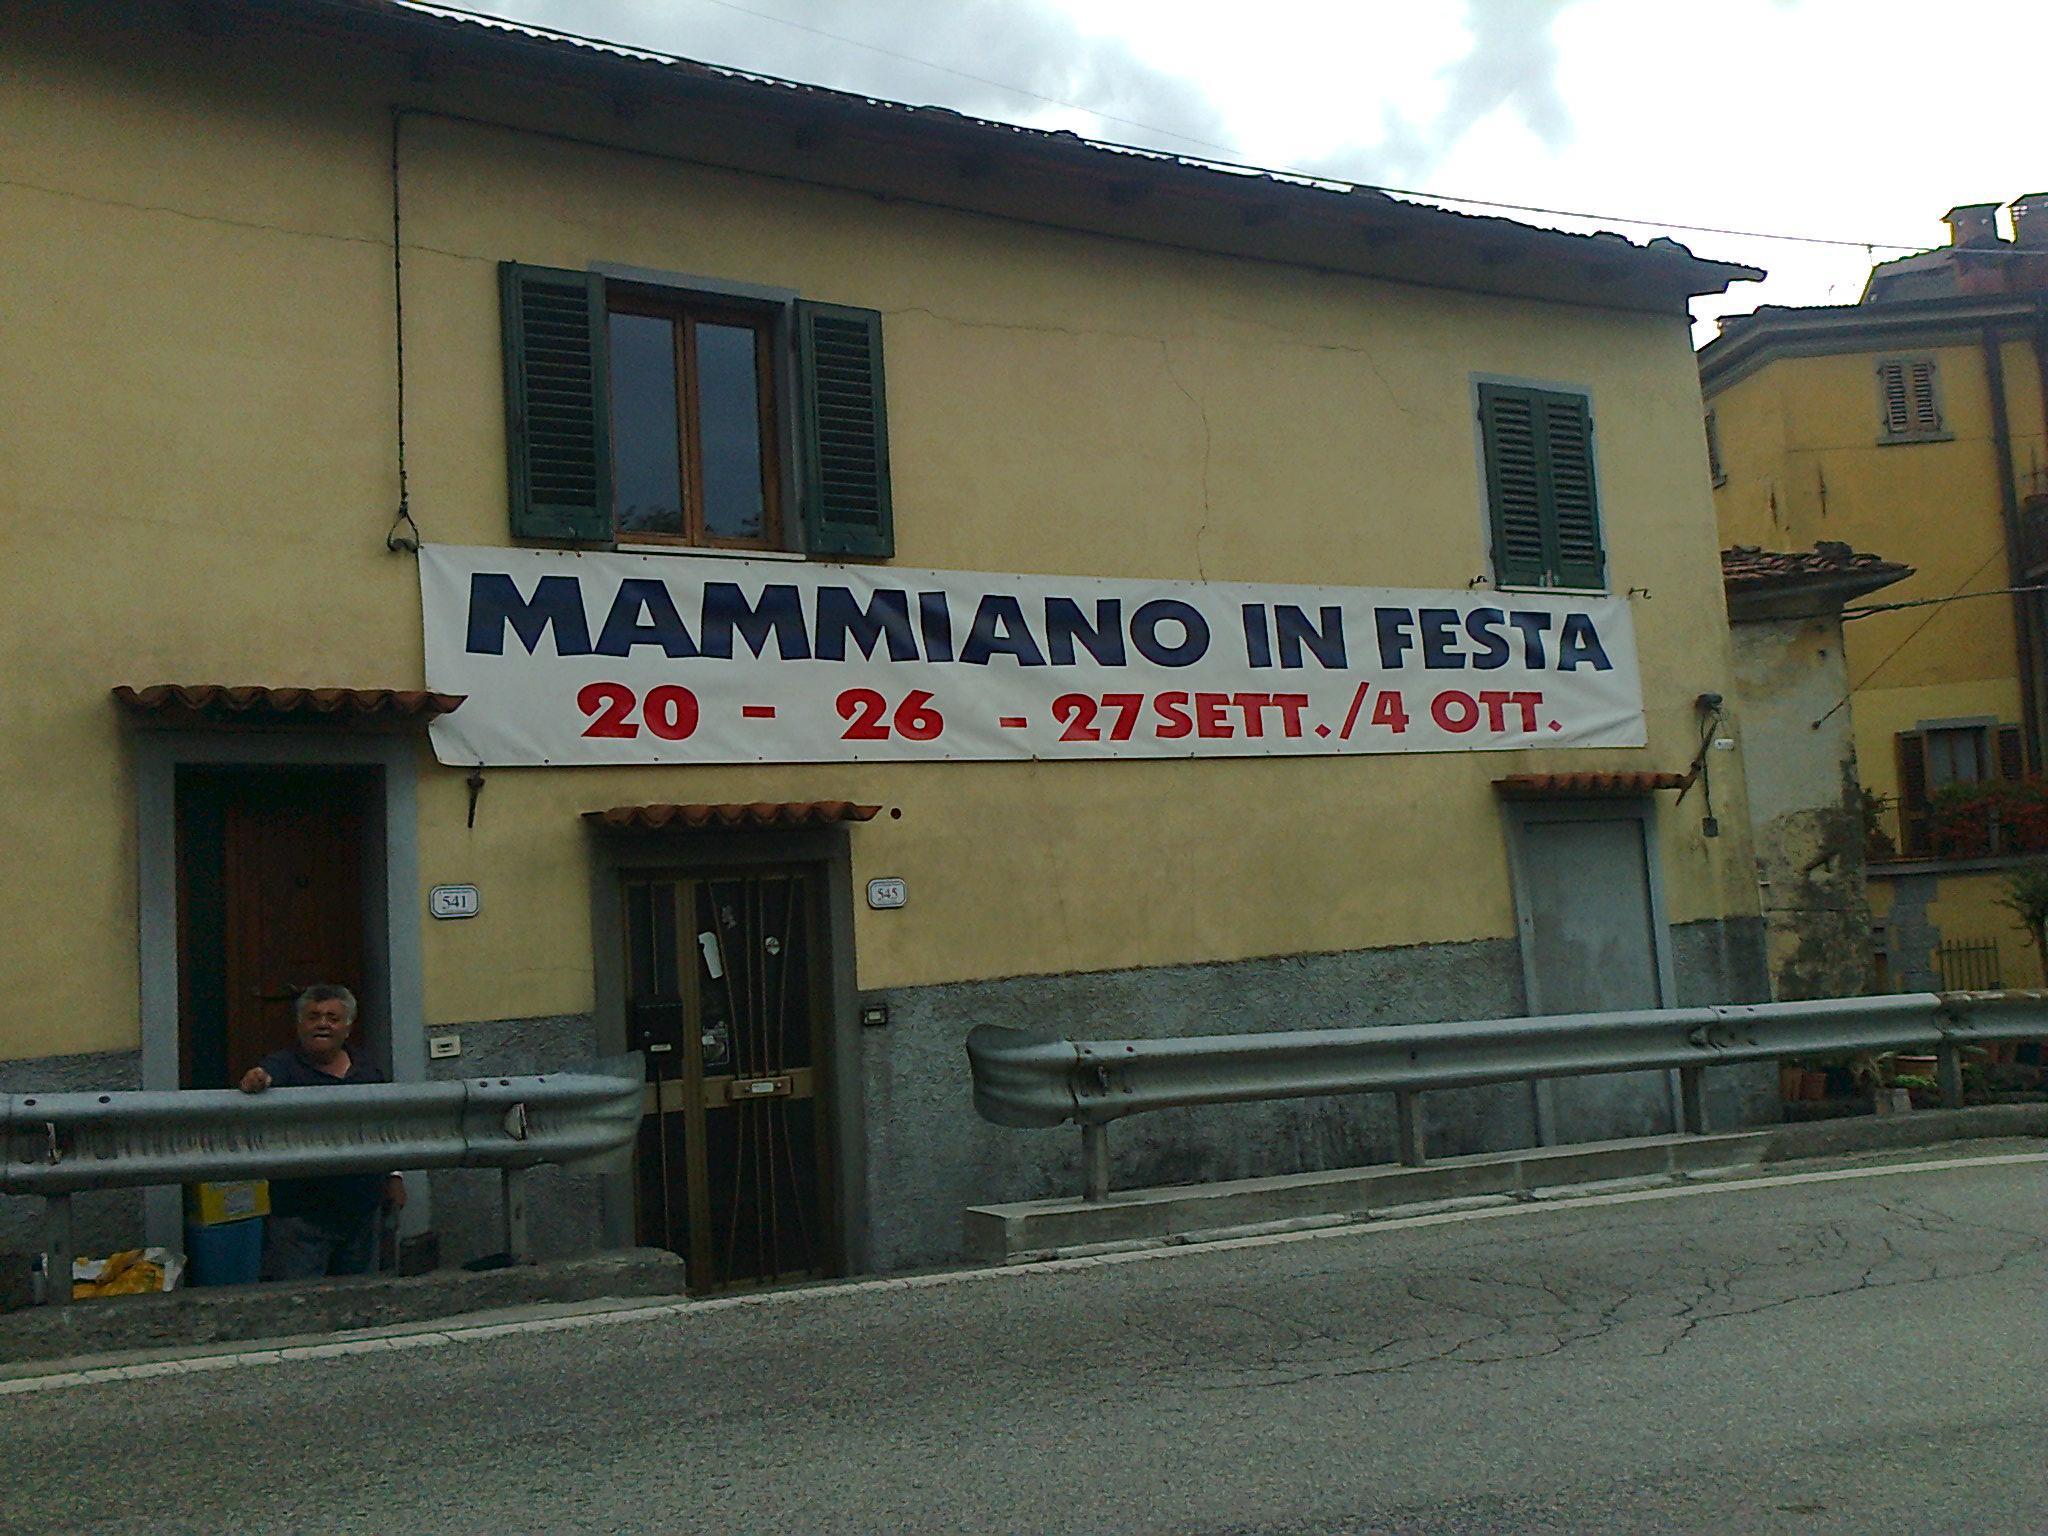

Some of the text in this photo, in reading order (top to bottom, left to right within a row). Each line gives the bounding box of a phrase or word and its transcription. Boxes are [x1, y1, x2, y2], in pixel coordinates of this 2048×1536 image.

[466, 572, 1614, 672] MAMMIANO IN FESTA
[577, 682, 699, 741] 20
[836, 688, 944, 741] 26
[1431, 690, 1563, 734] OTT.
[442, 895, 466, 909] 541
